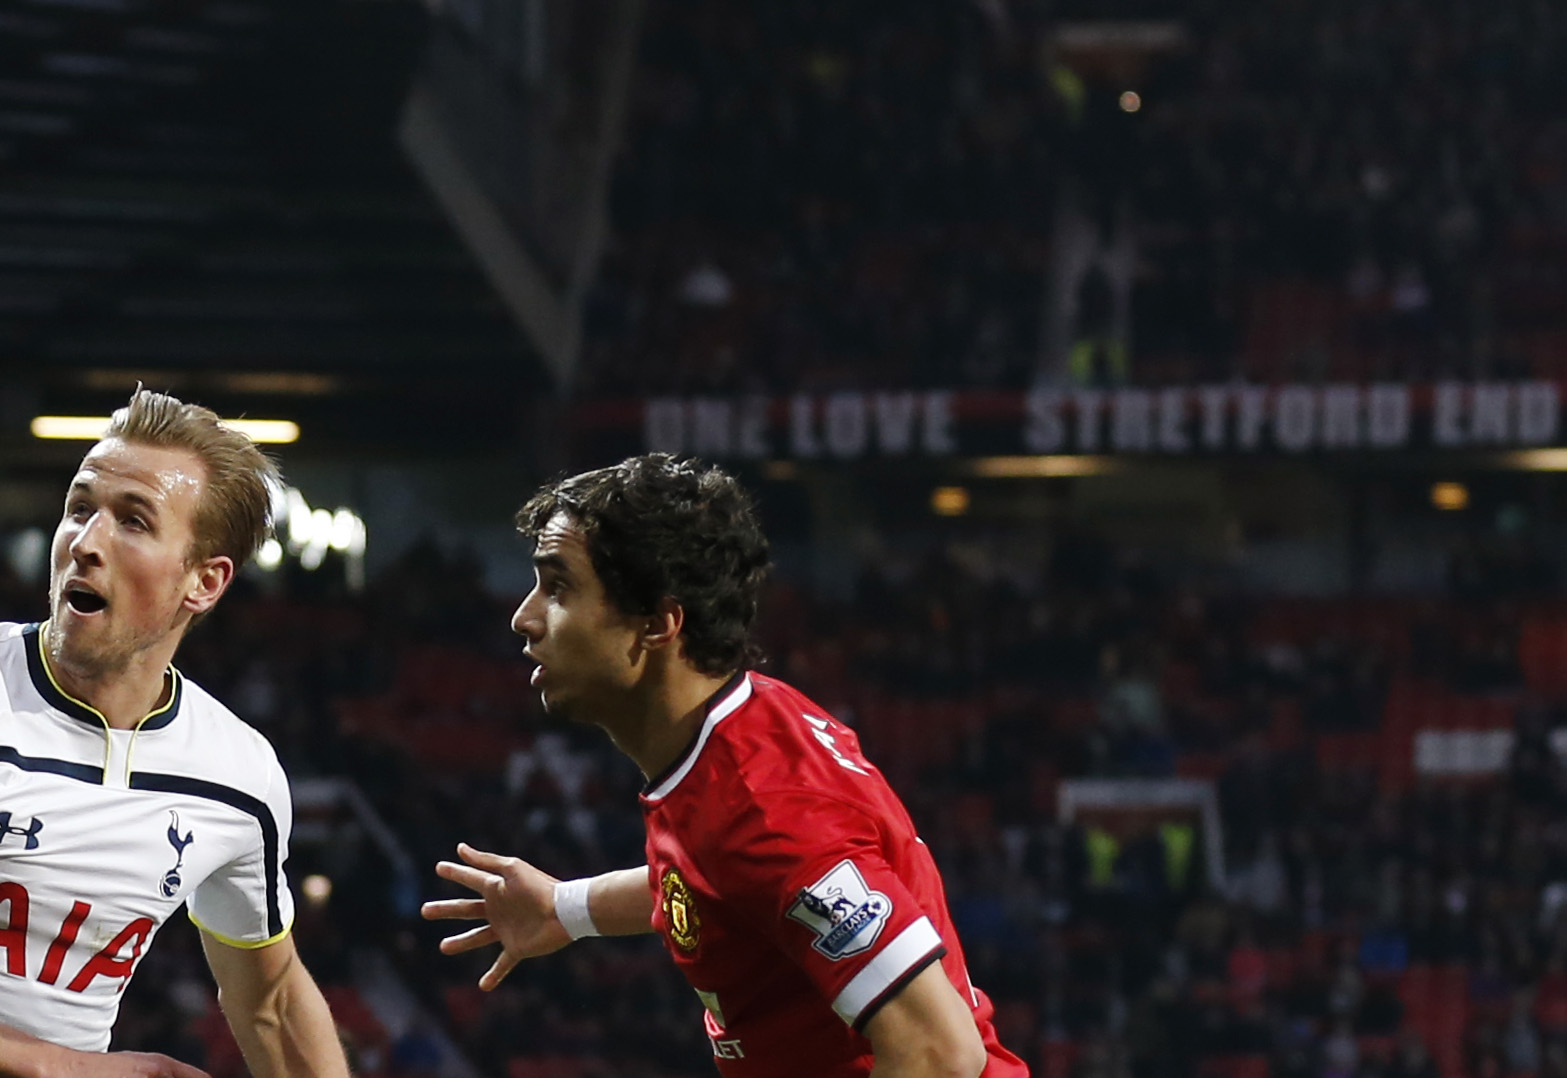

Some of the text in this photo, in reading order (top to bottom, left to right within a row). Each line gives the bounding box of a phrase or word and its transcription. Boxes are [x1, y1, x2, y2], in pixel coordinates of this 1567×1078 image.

[644, 380, 1559, 457] ONE LOVE STRETFORD END
[827, 907, 869, 946] BARCLAYS
